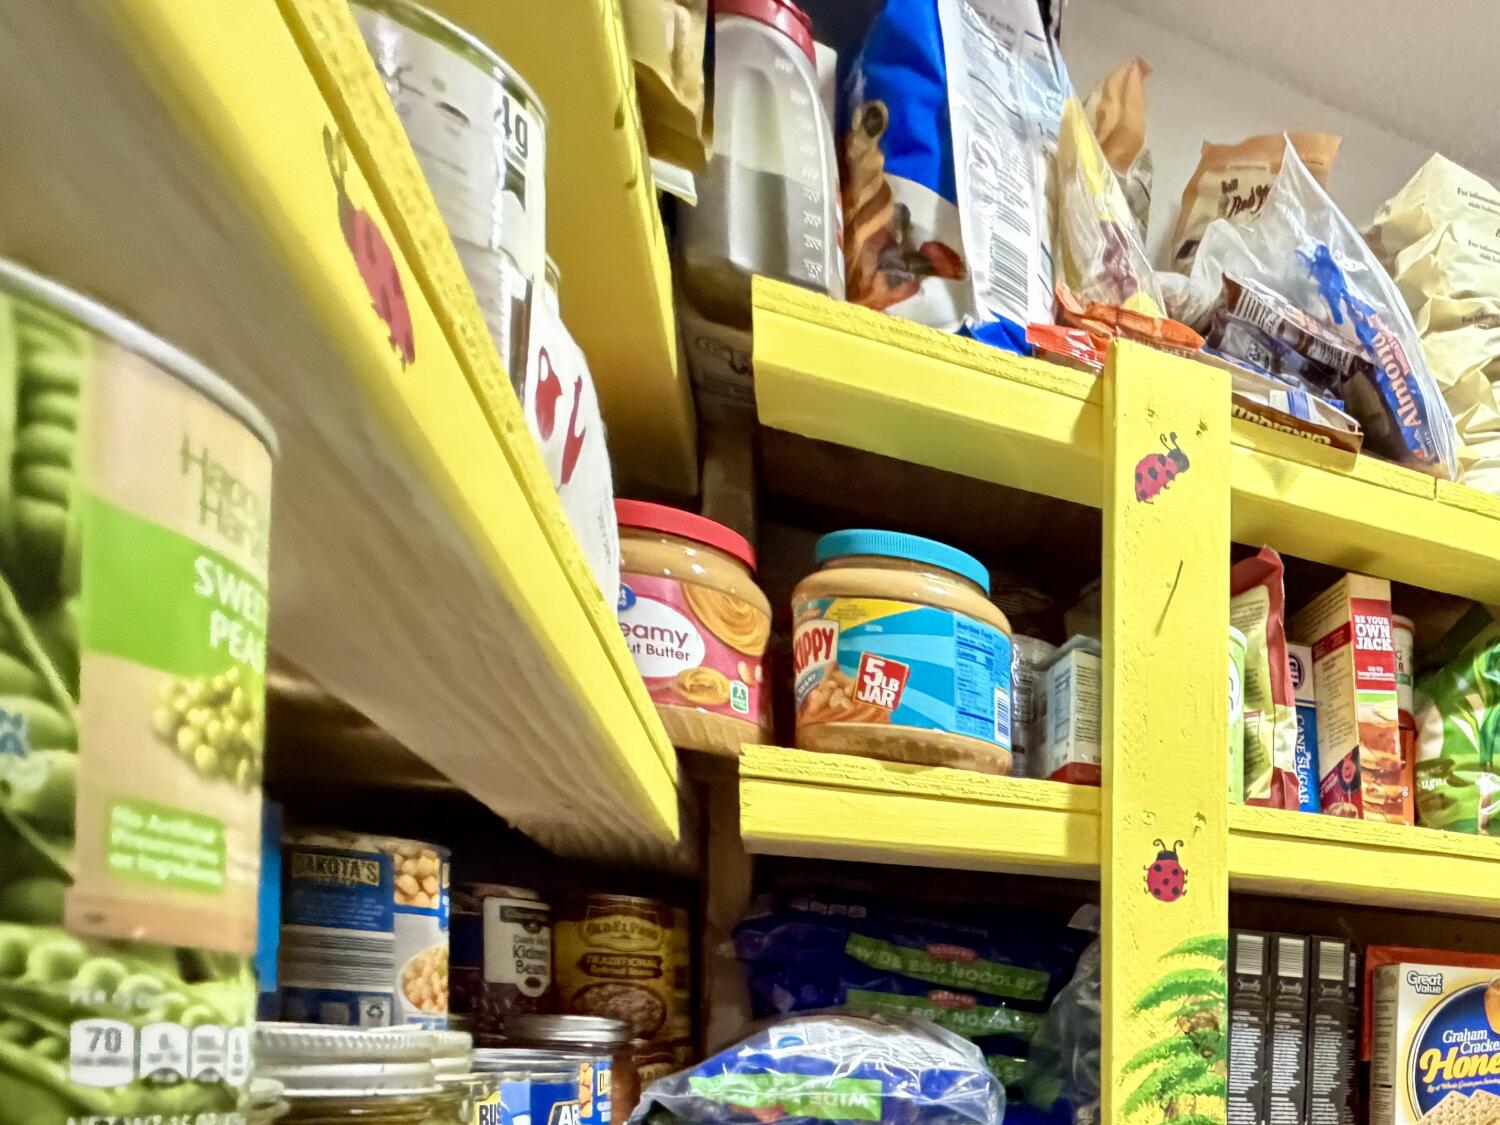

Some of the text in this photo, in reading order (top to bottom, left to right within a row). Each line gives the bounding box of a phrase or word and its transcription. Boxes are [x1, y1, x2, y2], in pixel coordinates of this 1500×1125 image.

[1354, 614, 1389, 627] BE YOUR
[1355, 624, 1391, 639] OWN
[209, 609, 266, 675] PEA
[619, 622, 689, 649] eamy
[1355, 637, 1394, 652] JACK
[646, 643, 690, 662] Butter
[794, 627, 835, 674] KIPPY
[863, 657, 885, 686] 5
[857, 685, 897, 709] JAR
[1296, 714, 1310, 804] CANE SUGAR
[294, 852, 380, 886] AKOTA'S
[1407, 970, 1443, 988] Great
[1415, 984, 1443, 996] Value
[85, 1026, 122, 1053] 70
[1442, 1028, 1488, 1045] Graham
